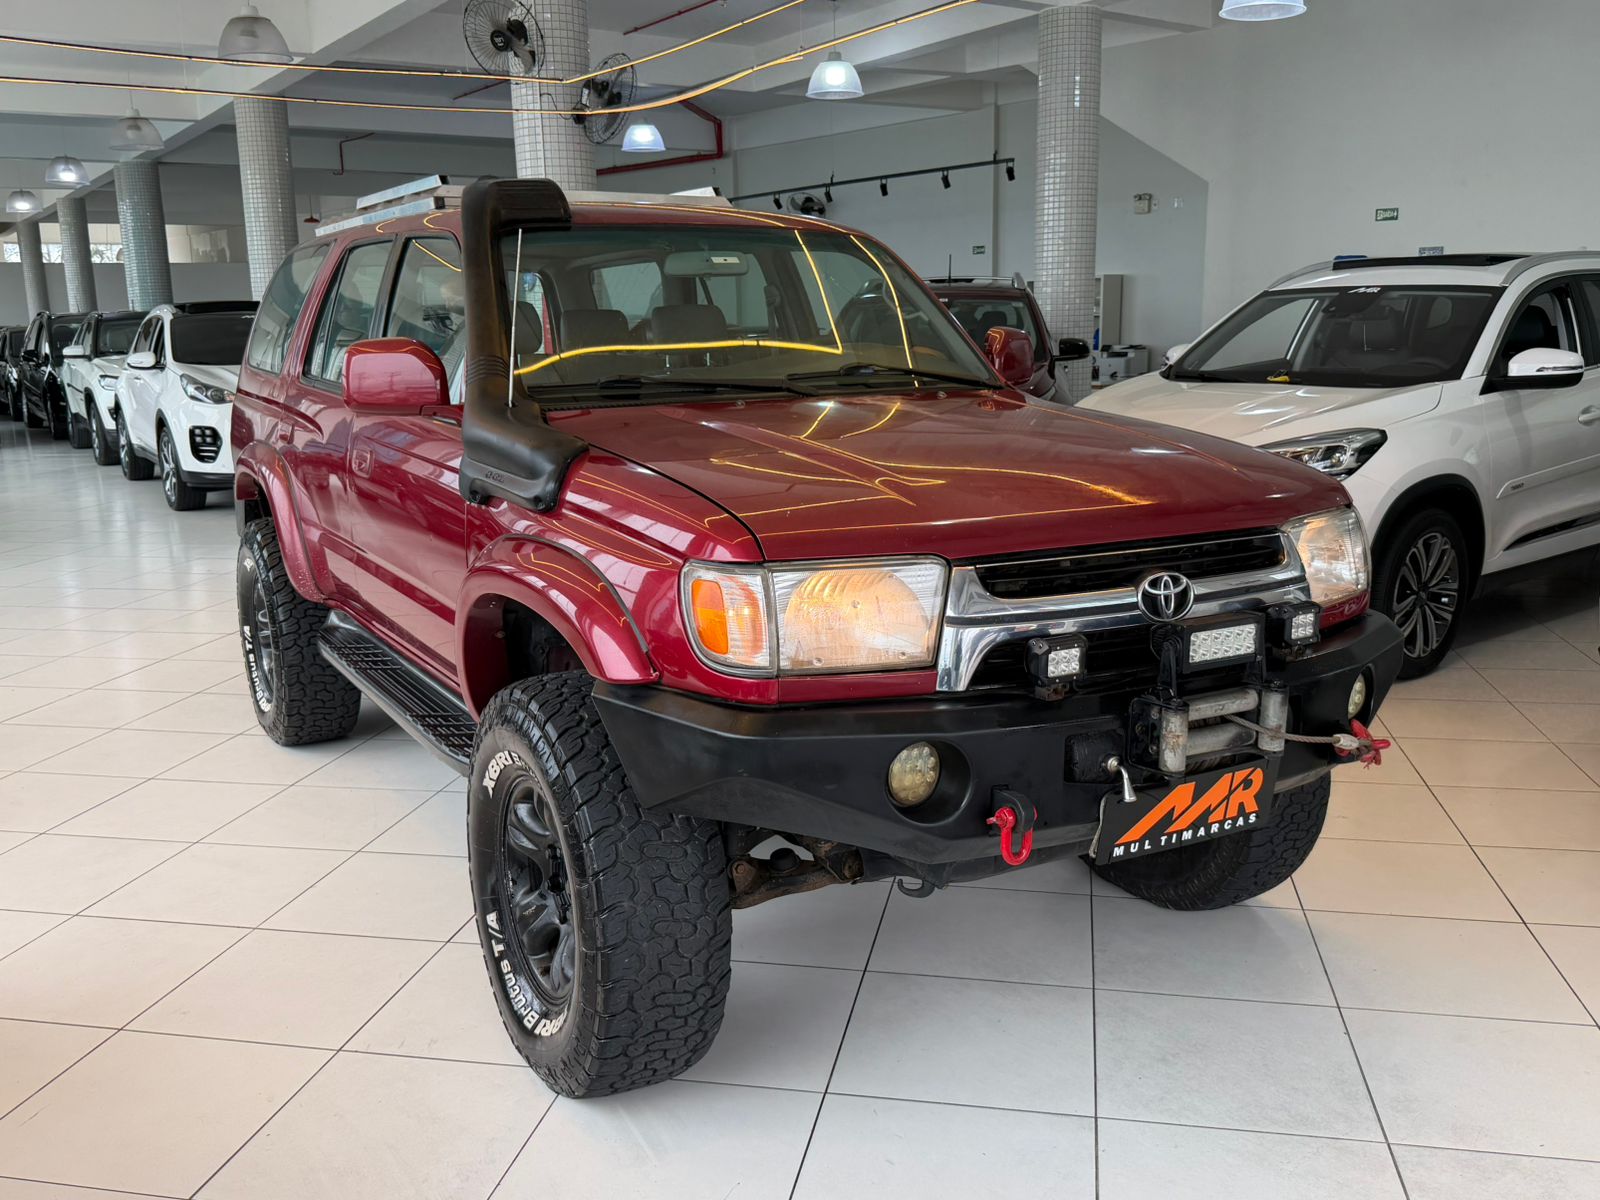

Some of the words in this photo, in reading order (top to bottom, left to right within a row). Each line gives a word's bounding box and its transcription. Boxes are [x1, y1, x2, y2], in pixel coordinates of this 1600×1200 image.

[482, 750, 513, 799] XBRI
[1113, 812, 1257, 858] MULTIMARCAS
[486, 910, 506, 958] T/A
[500, 959, 540, 1031] Brutus
